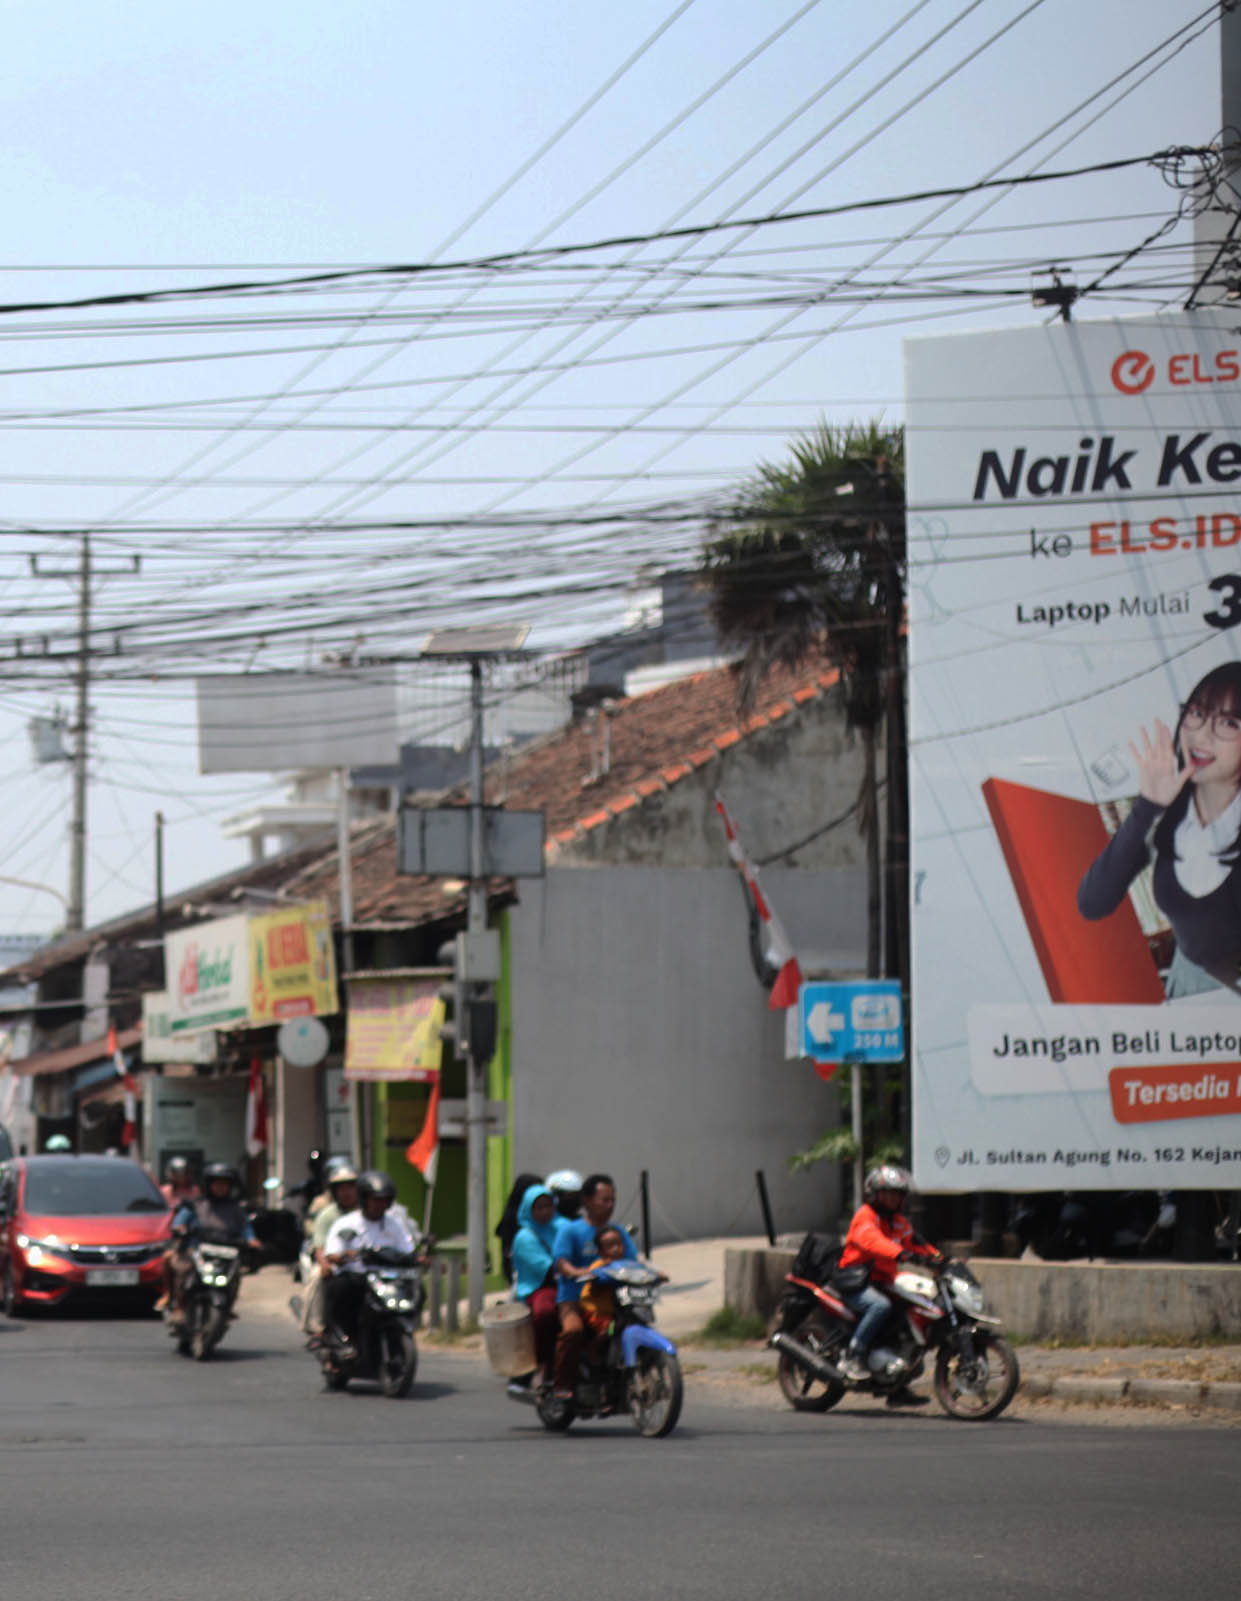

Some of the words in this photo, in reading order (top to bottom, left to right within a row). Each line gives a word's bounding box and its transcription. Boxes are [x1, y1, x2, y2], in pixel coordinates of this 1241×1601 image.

[972, 436, 1138, 501] Naik
[1029, 527, 1073, 560] ke
[1089, 512, 1241, 557] ELS.ID
[1016, 600, 1111, 627] Laptop
[1119, 592, 1191, 618] Mulai
[992, 1033, 1101, 1063] Jangan
[1111, 1030, 1161, 1054] Beli
[1170, 1031, 1241, 1057] Lapto
[1124, 1073, 1231, 1106] Tersedia
[957, 1149, 980, 1166] Jl.
[986, 1149, 1048, 1166] Sultan
[1052, 1149, 1112, 1168] Agung
[1116, 1148, 1148, 1164] No.
[1154, 1147, 1186, 1163] 162
